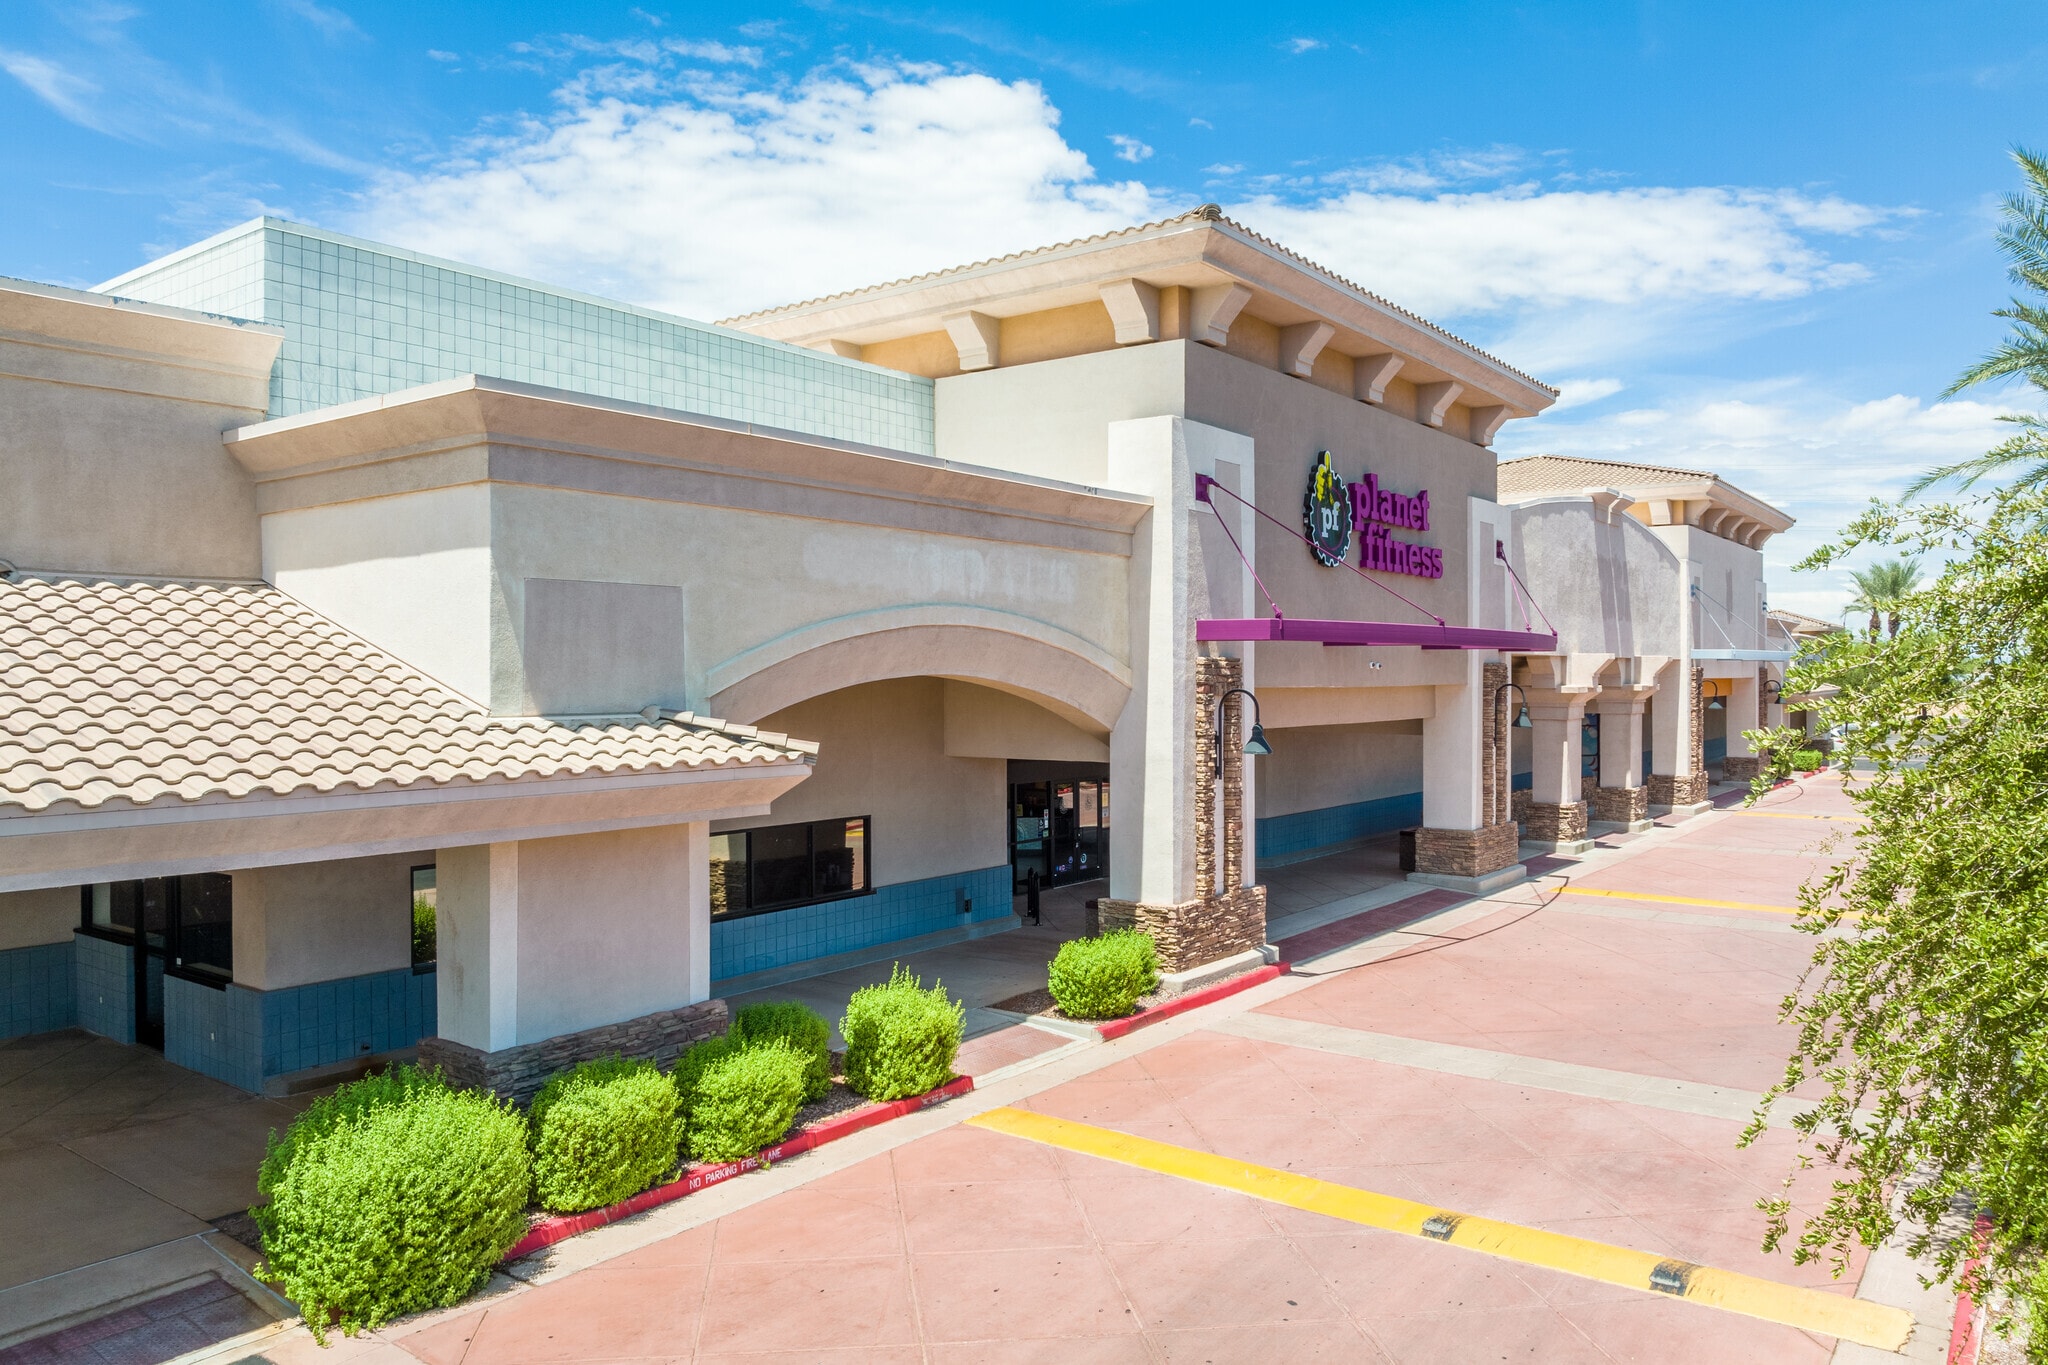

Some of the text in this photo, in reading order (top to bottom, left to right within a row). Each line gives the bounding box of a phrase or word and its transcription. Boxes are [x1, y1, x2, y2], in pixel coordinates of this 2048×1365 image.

[1321, 501, 1341, 538] pf
[1350, 473, 1430, 531] planet
[1360, 522, 1443, 579] fitness
[689, 1147, 782, 1190] NO PARKING FIRE LANE
